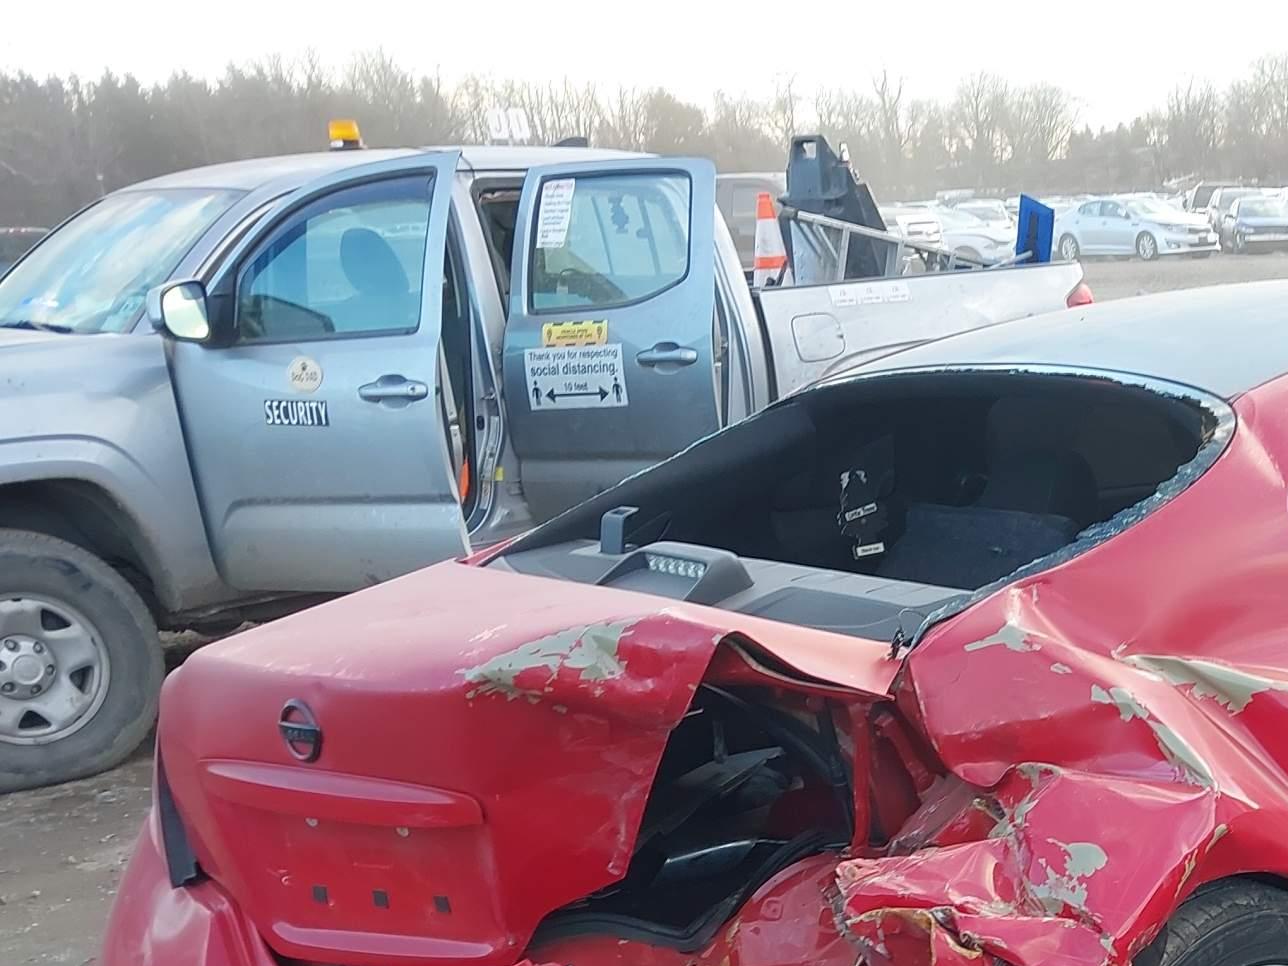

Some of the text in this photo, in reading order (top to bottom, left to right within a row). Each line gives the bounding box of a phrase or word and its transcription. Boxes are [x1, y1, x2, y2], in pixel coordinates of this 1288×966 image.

[529, 347, 618, 362] Thank you for respecting
[530, 360, 618, 377] social distancing.
[563, 380, 588, 392] 10 feet
[264, 400, 326, 426] SECURITY
